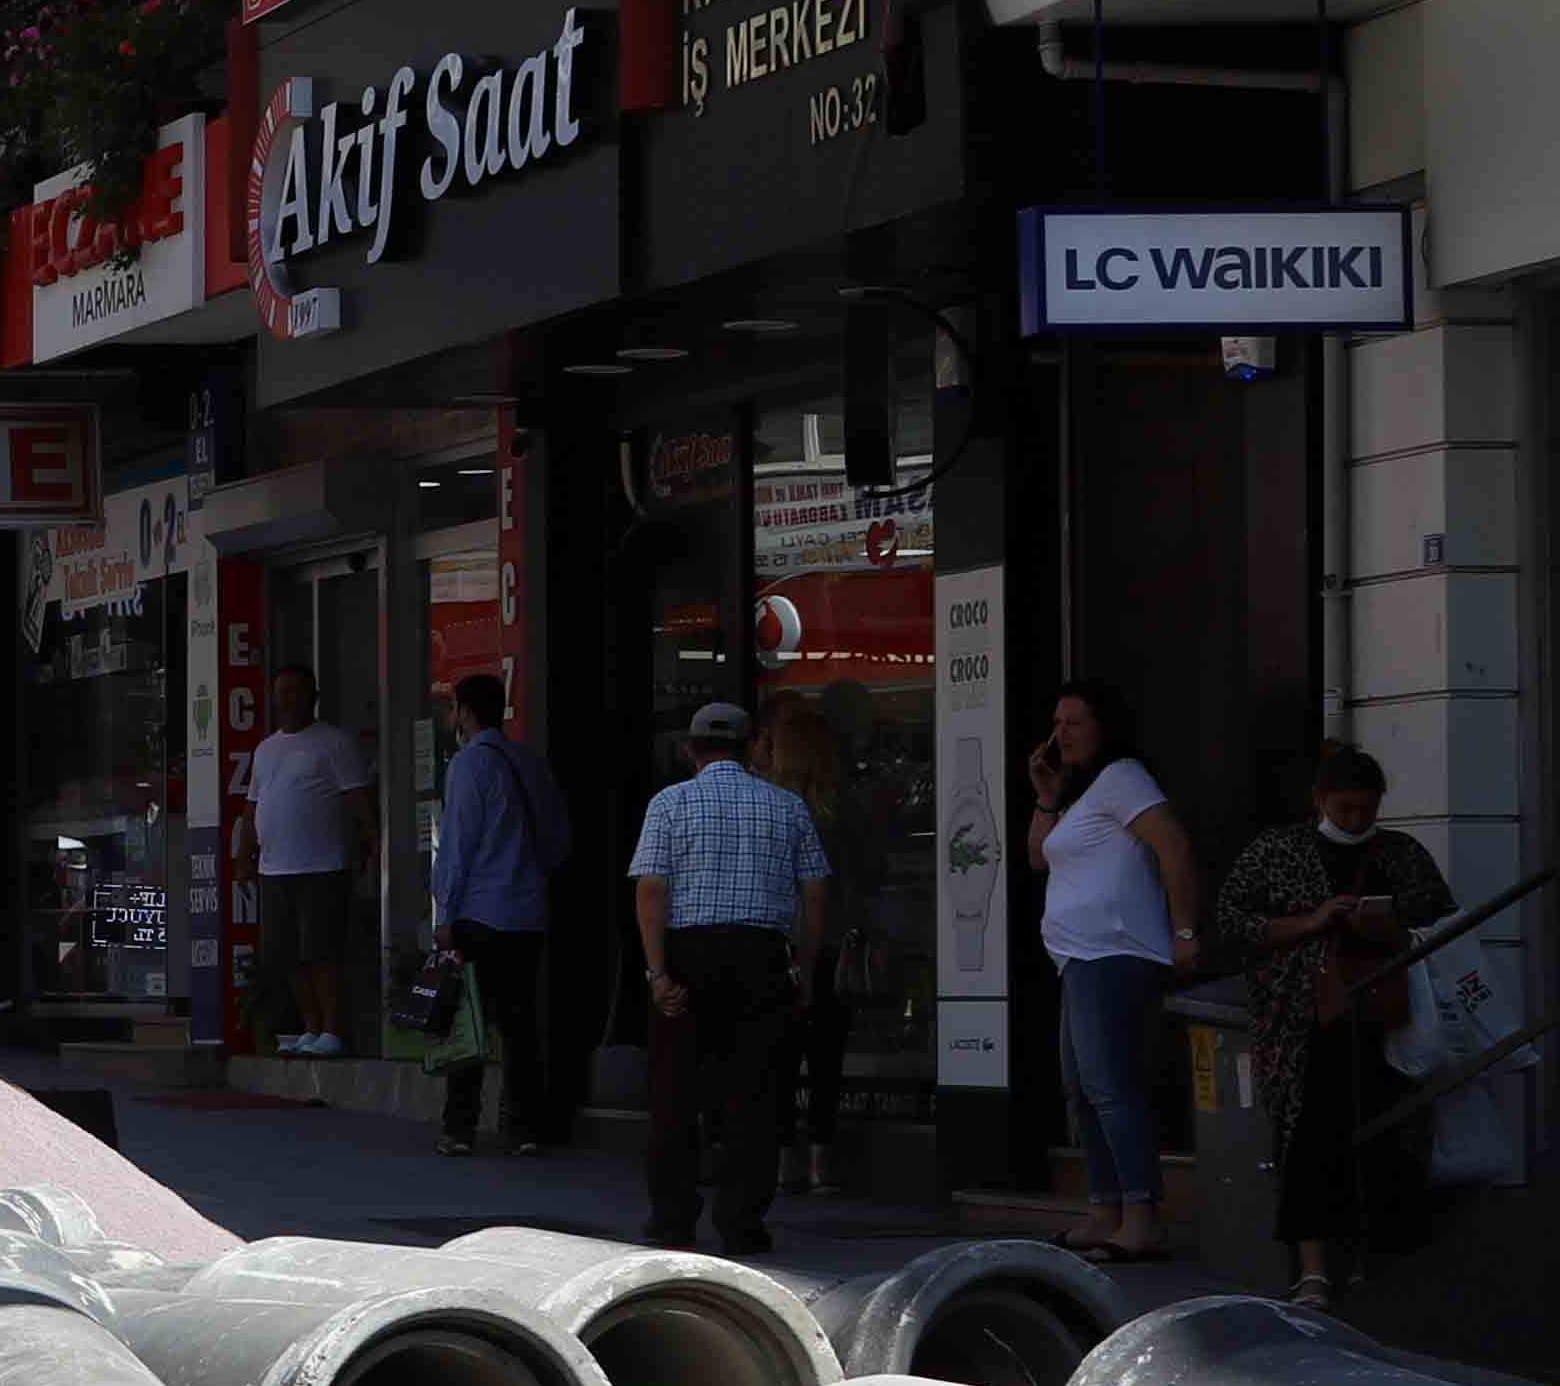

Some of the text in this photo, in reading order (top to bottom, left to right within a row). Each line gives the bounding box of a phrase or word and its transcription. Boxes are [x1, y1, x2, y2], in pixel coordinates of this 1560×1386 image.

[681, 31, 709, 117] İŞ
[271, 6, 587, 266] Akif Saat
[808, 74, 877, 147] NO:32
[1065, 247, 1139, 291] LC
[71, 277, 146, 329] MARMARA
[949, 600, 989, 629] CROCO
[949, 654, 989, 683] CROCO
